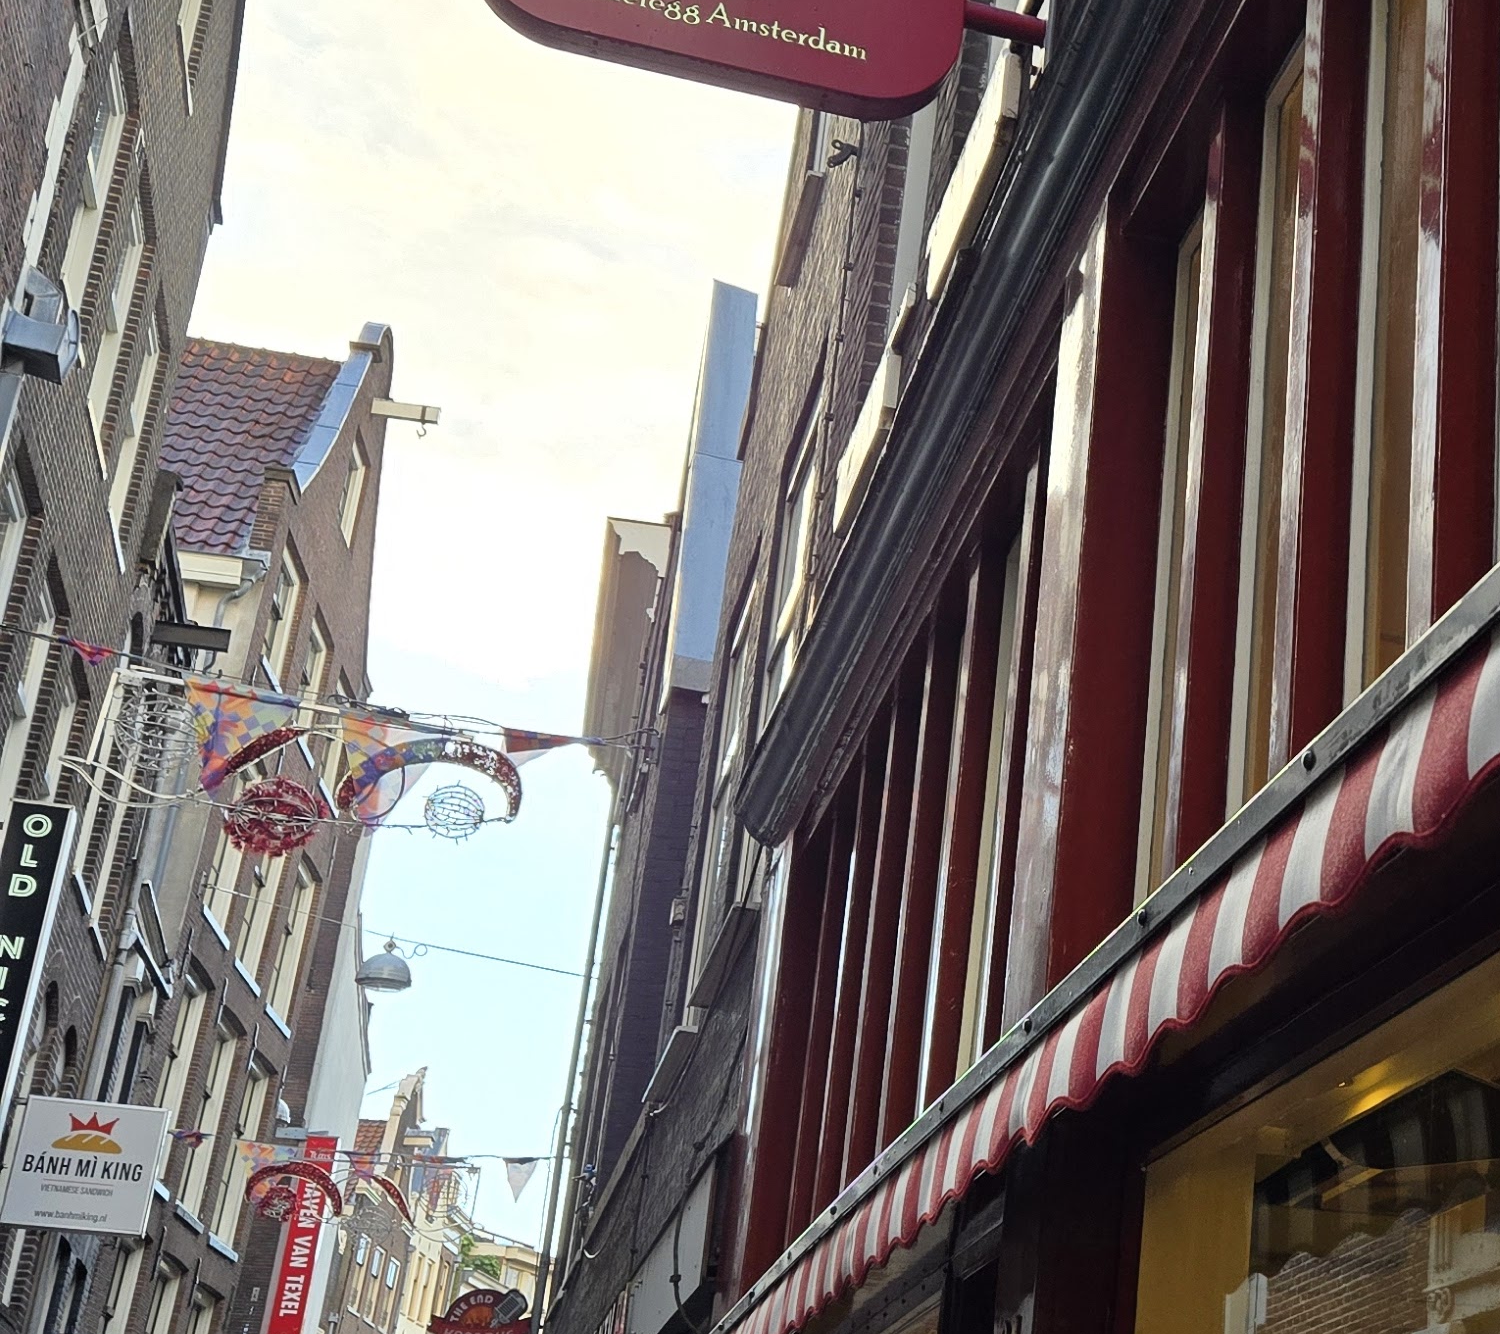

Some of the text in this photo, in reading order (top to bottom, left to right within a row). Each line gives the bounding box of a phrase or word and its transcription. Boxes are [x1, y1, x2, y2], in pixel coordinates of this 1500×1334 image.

[705, 2, 867, 61] Amsterdam
[8, 813, 52, 898] OLD
[22, 1152, 143, 1182] BÁNH MÌ KING
[289, 1235, 313, 1268] VAN
[279, 1274, 305, 1317] TEXEL
[450, 1294, 494, 1322] THE END
